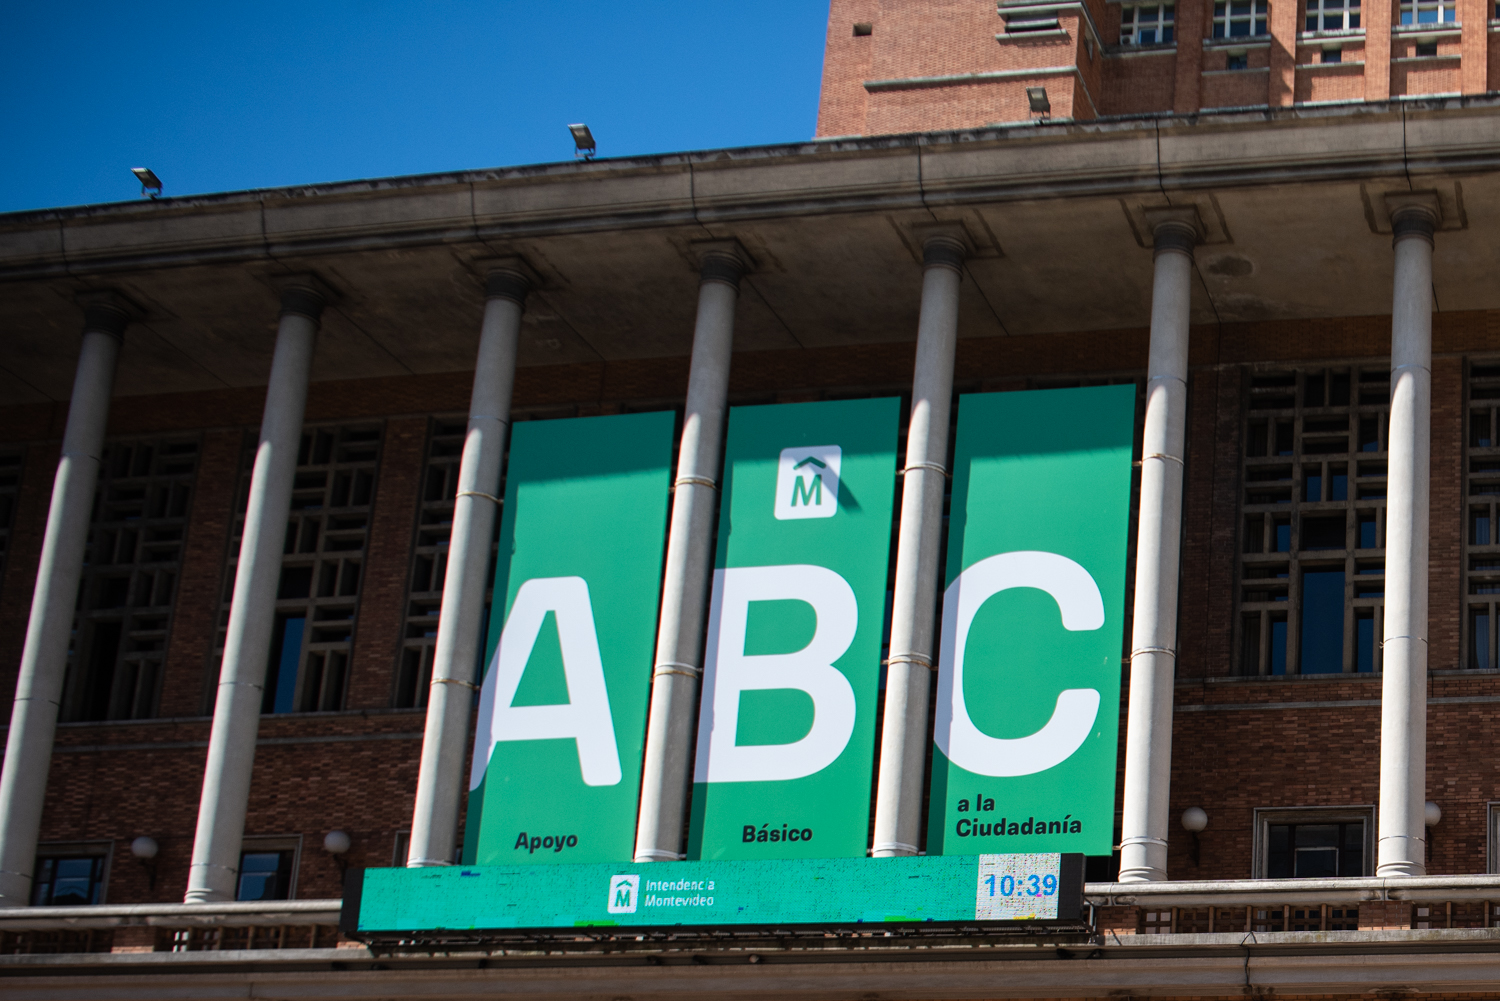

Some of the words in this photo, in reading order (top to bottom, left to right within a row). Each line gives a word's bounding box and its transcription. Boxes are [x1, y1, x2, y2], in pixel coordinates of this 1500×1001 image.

[469, 575, 622, 791] A
[693, 563, 860, 783] B
[933, 550, 1106, 778] C
[956, 797, 971, 813] a
[975, 793, 996, 813] la
[741, 822, 814, 846] Básico
[955, 814, 1083, 839] Ciudadanía
[514, 830, 579, 854] Apoyo
[645, 877, 716, 892] Intendencia
[984, 872, 1060, 900] 10:39
[644, 893, 715, 908] Montevideo
